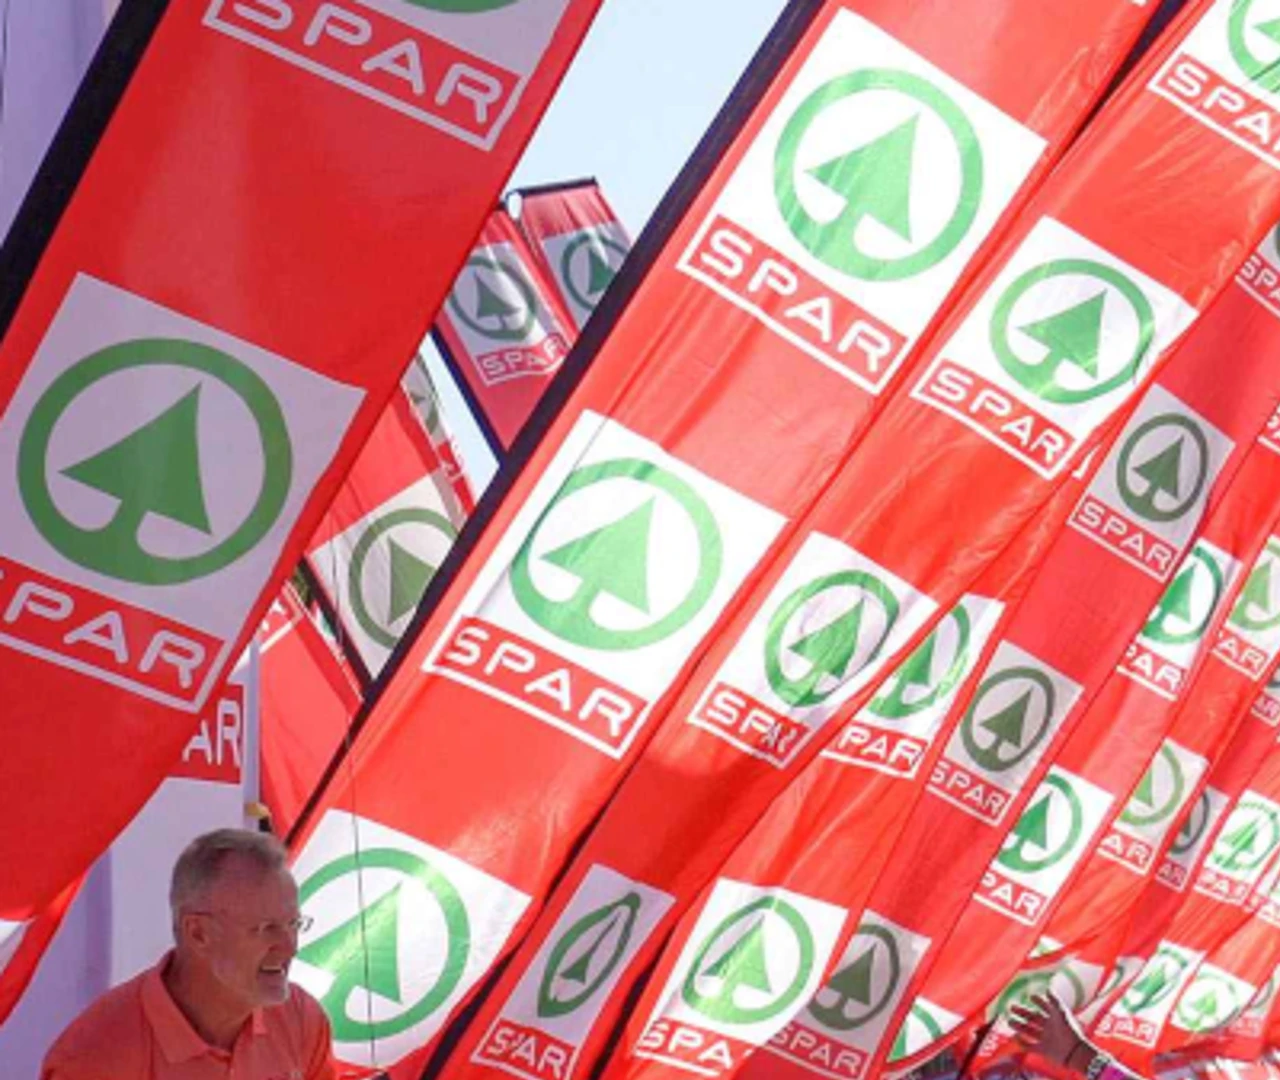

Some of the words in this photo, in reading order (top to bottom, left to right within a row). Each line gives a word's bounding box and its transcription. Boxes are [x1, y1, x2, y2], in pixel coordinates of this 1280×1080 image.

[700, 228, 894, 374] SPAR
[930, 367, 1067, 463] SPAR
[1079, 501, 1175, 572] SPAR
[0, 569, 206, 688] PAR
[446, 626, 635, 738] SPAR
[837, 727, 923, 768] PAR
[931, 760, 1008, 816] SPAR
[641, 1021, 735, 1071] SPA
[770, 1023, 861, 1076] SPAR
